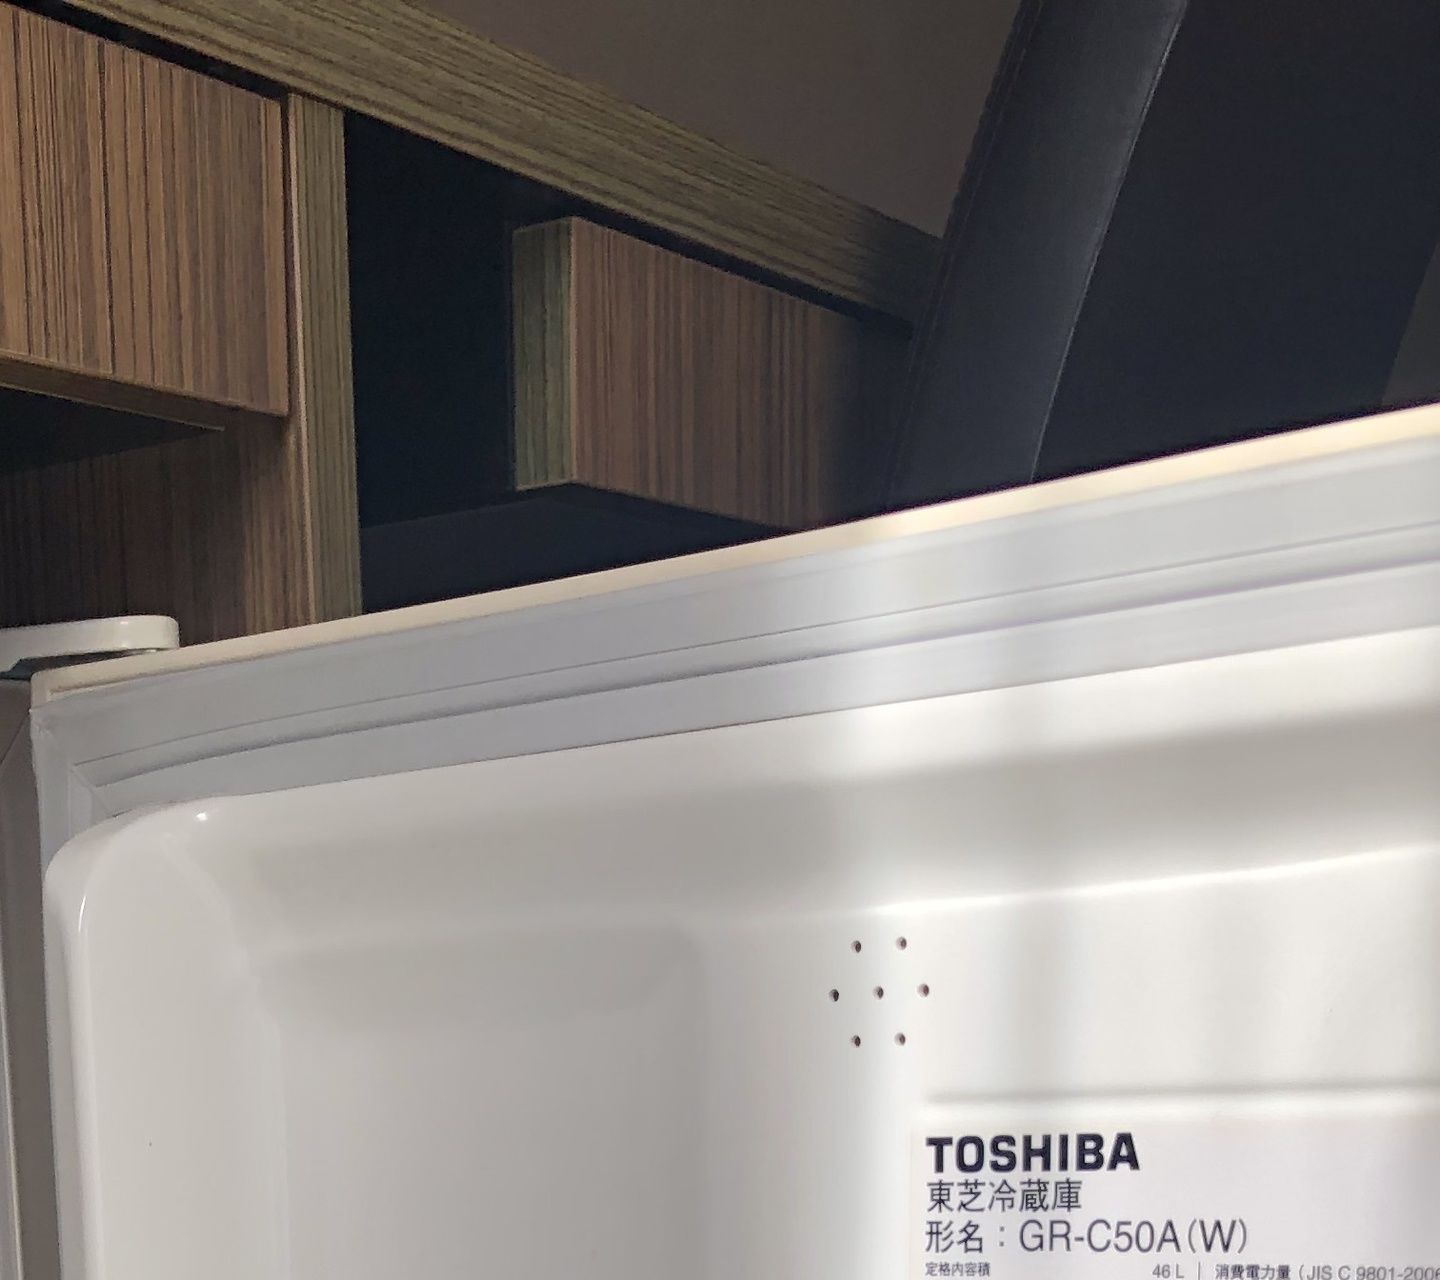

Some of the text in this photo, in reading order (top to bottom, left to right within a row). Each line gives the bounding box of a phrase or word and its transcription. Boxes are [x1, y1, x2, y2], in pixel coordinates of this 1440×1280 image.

[925, 1132, 1141, 1173] TOSHIBA
[926, 1178, 1082, 1213] 東芝冷蔵庫
[925, 1262, 1185, 1279] 定格内容積 46 L
